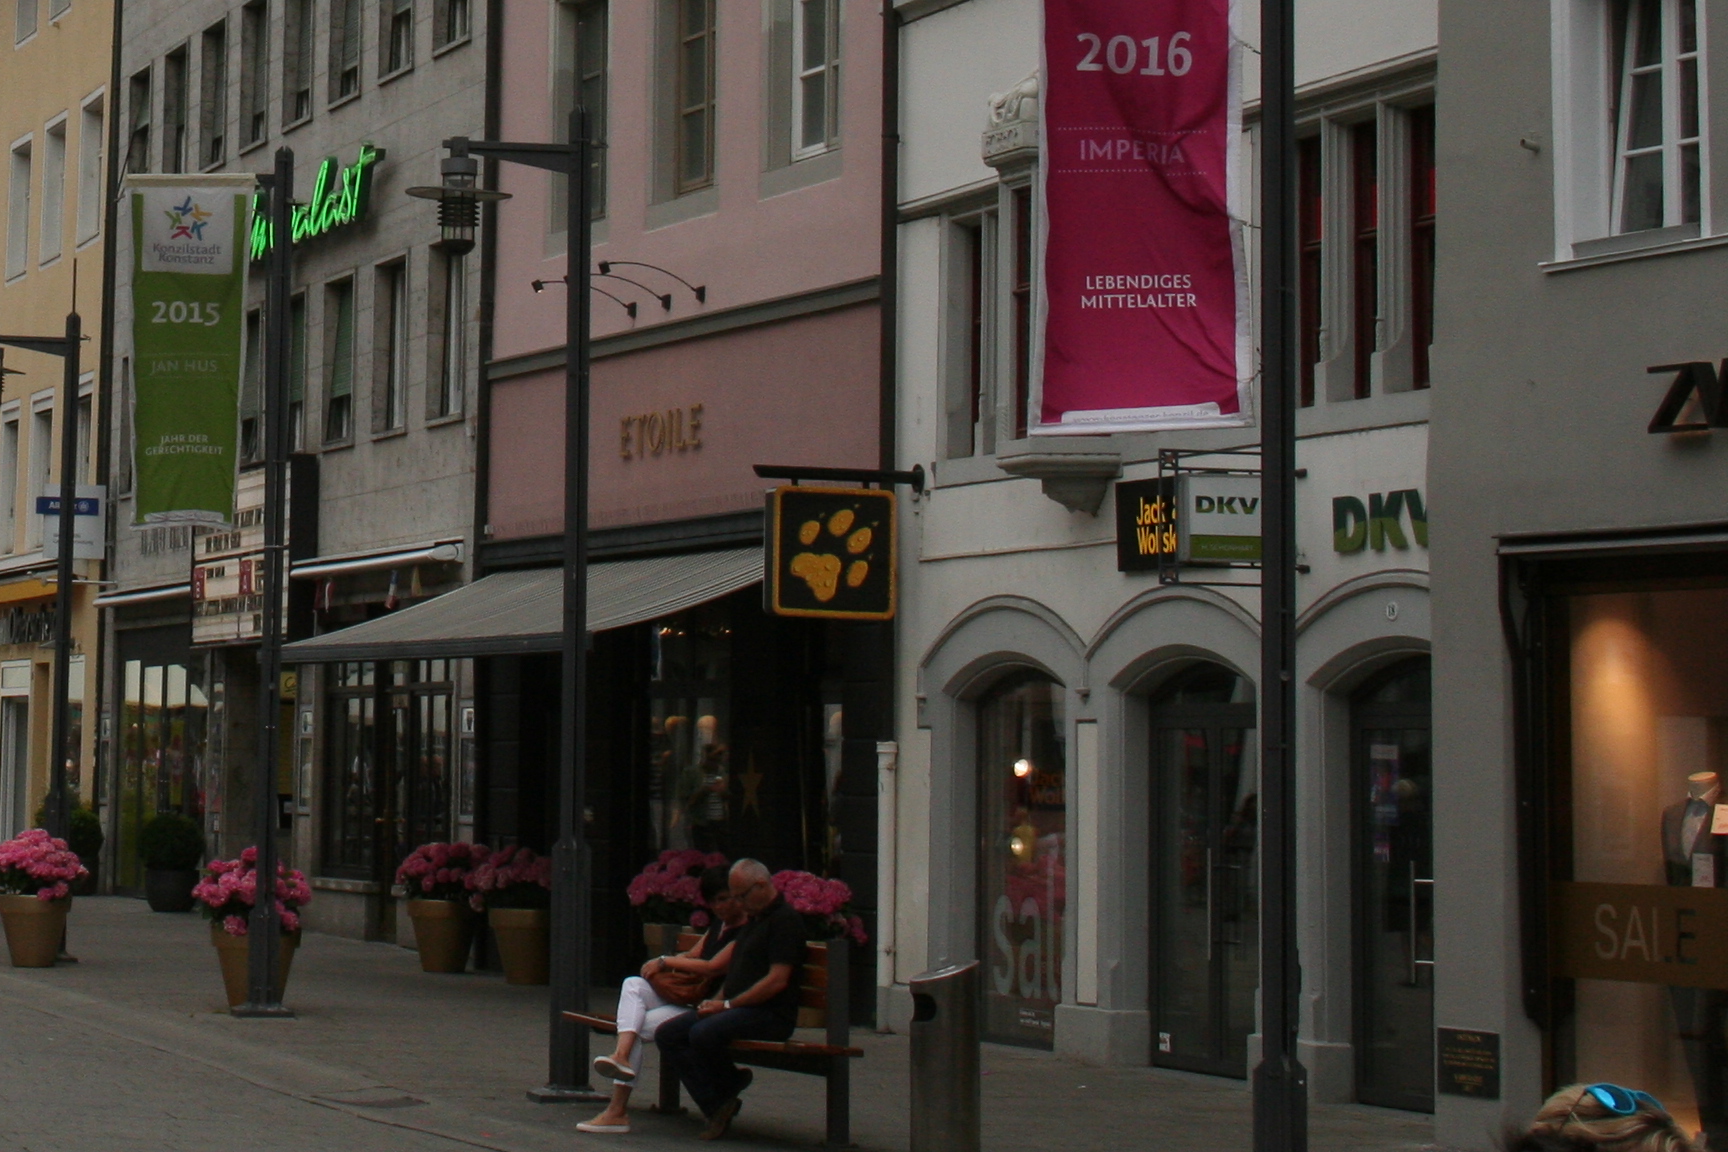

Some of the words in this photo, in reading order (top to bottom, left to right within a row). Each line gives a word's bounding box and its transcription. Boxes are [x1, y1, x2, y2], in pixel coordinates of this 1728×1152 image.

[1076, 31, 1193, 77] 2016
[1080, 139, 1185, 165] IMPERIA
[152, 243, 222, 255] Konzilstadt
[158, 253, 215, 264] Konstanz
[1085, 274, 1192, 290] LEBENDIGES
[1081, 293, 1197, 309] MITTELALTER
[152, 300, 221, 326] 2015
[150, 359, 179, 376] JAN
[184, 359, 218, 372] HUS
[161, 434, 185, 446] JAHR
[188, 434, 208, 444] DER
[619, 403, 703, 460] ETOILE
[145, 444, 223, 456] GERECHTIGKEIT
[1195, 495, 1260, 515] DKV
[1594, 903, 1698, 966] SALE
